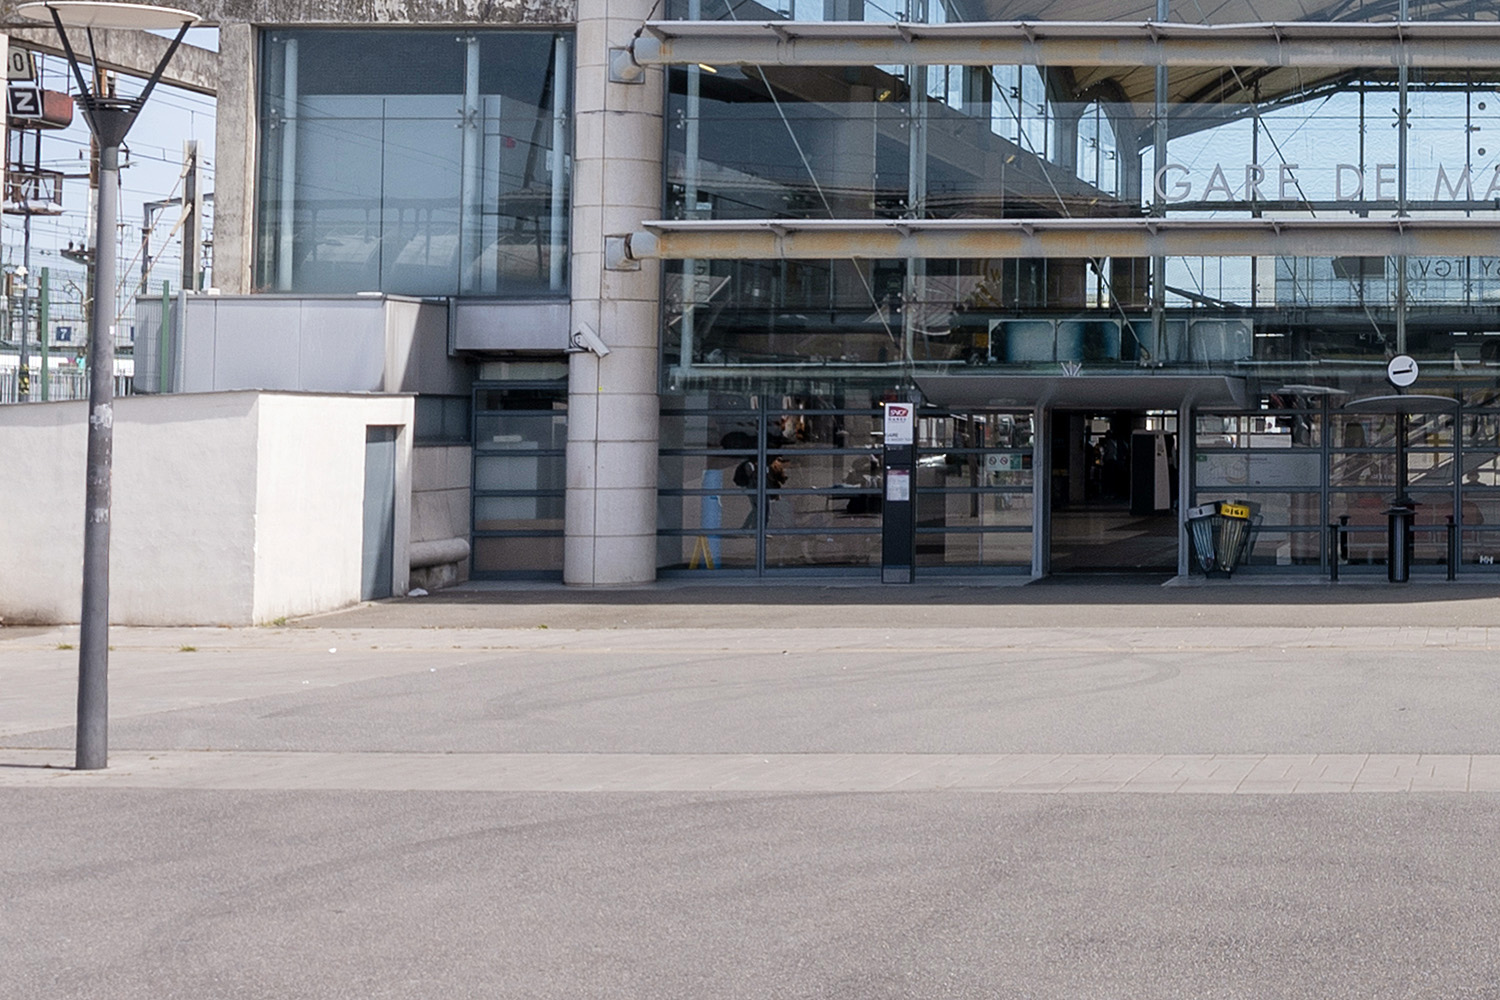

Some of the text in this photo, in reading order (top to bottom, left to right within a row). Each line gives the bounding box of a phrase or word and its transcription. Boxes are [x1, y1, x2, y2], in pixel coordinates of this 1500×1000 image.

[8, 52, 24, 72] 0
[14, 92, 35, 111] Z
[1154, 163, 1299, 201] GARE
[1336, 163, 1396, 201] DE
[60, 328, 67, 339] 7
